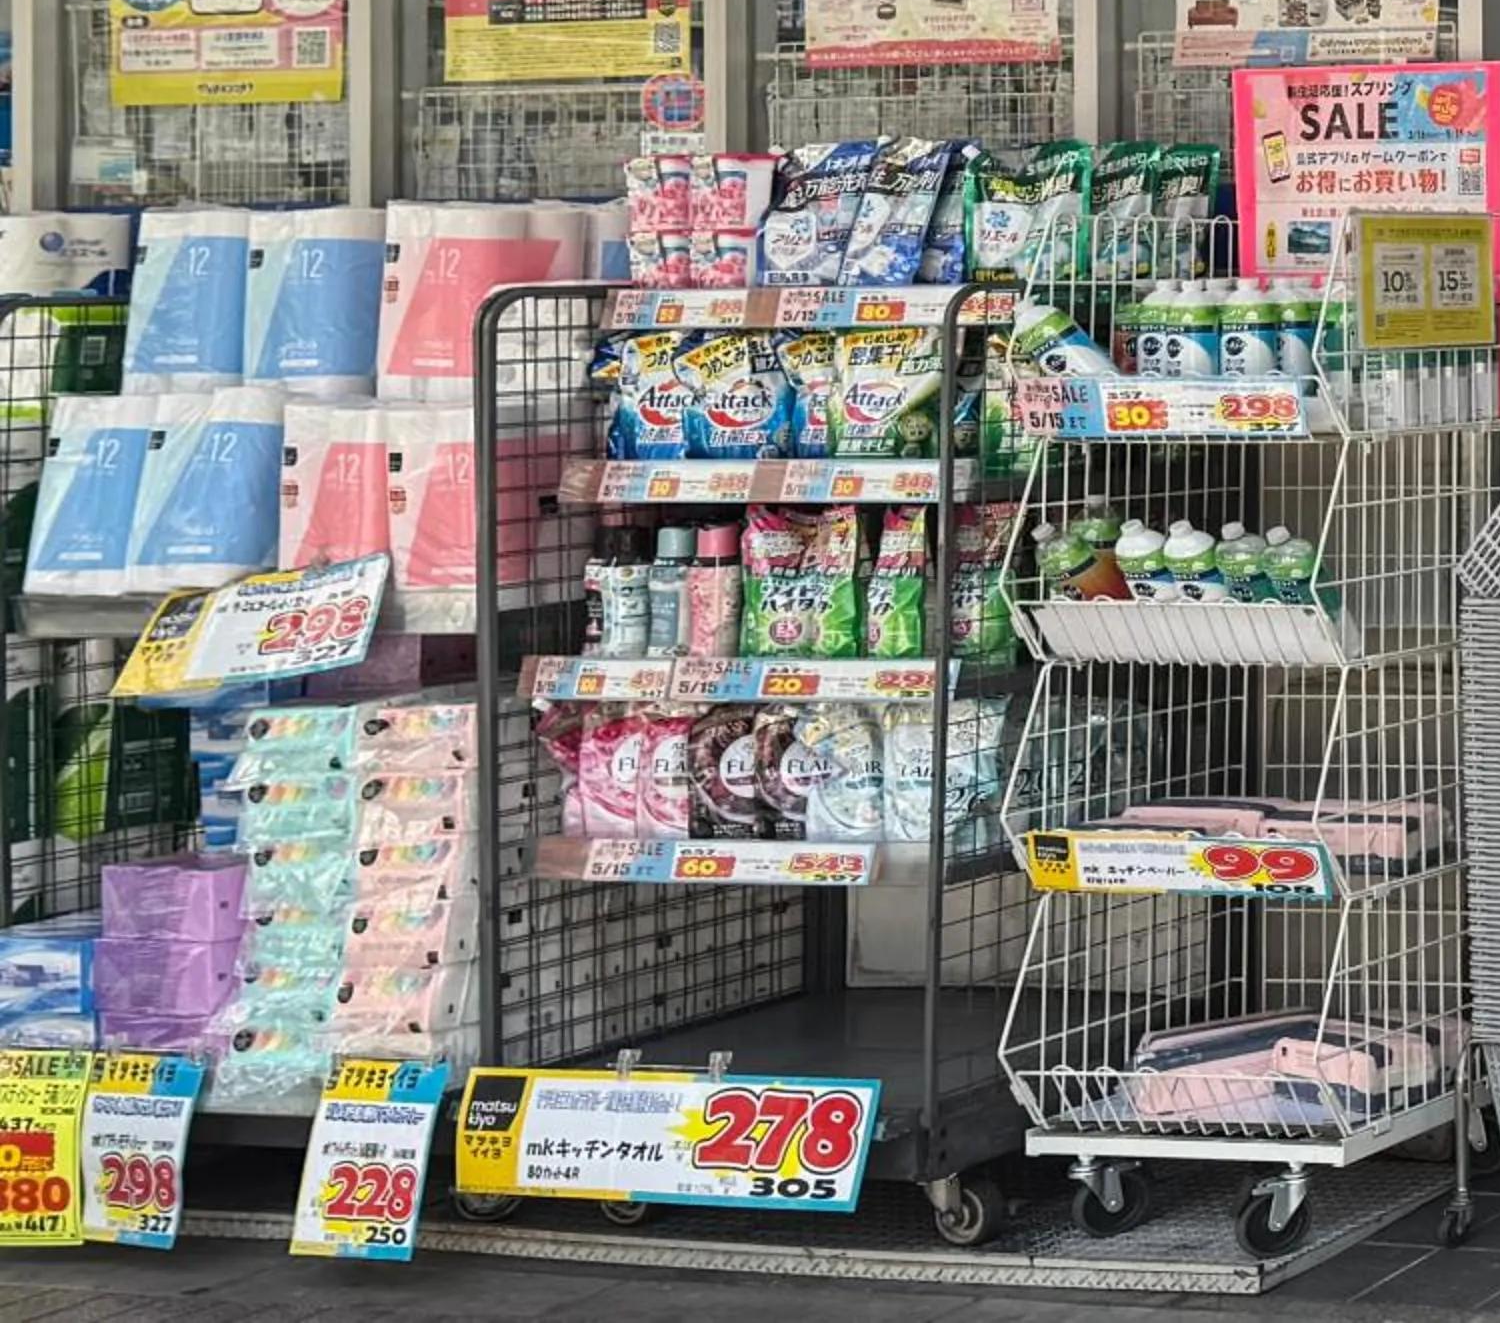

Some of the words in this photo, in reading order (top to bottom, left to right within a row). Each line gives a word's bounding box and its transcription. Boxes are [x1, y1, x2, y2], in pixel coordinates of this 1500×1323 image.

[1351, 79, 1412, 97] スプリング
[1300, 102, 1398, 140] SALE
[1296, 168, 1447, 195] お得にお買い物!
[1052, 385, 1088, 403] SALE
[1220, 394, 1301, 420] 298
[1030, 412, 1065, 430] 5/15
[1115, 407, 1150, 426] 30
[259, 596, 370, 654] 298
[715, 661, 751, 675] SALE
[679, 682, 718, 694] 5/15
[769, 678, 801, 693] 20
[592, 862, 630, 876] 5/15
[681, 859, 718, 874] 60
[788, 853, 865, 873] 543
[1204, 845, 1318, 882] 99
[13, 1056, 59, 1076] SALE
[471, 1099, 517, 1114] matsu
[468, 1111, 496, 1129] kiyo
[694, 1088, 864, 1173] 278
[464, 1135, 512, 1147] マツキヨ
[470, 1147, 502, 1159] イイヨ
[99, 1151, 177, 1213] 298
[749, 1177, 838, 1199] 305
[325, 1160, 417, 1225] 228
[139, 1215, 173, 1232] 327
[365, 1227, 407, 1245] 250
